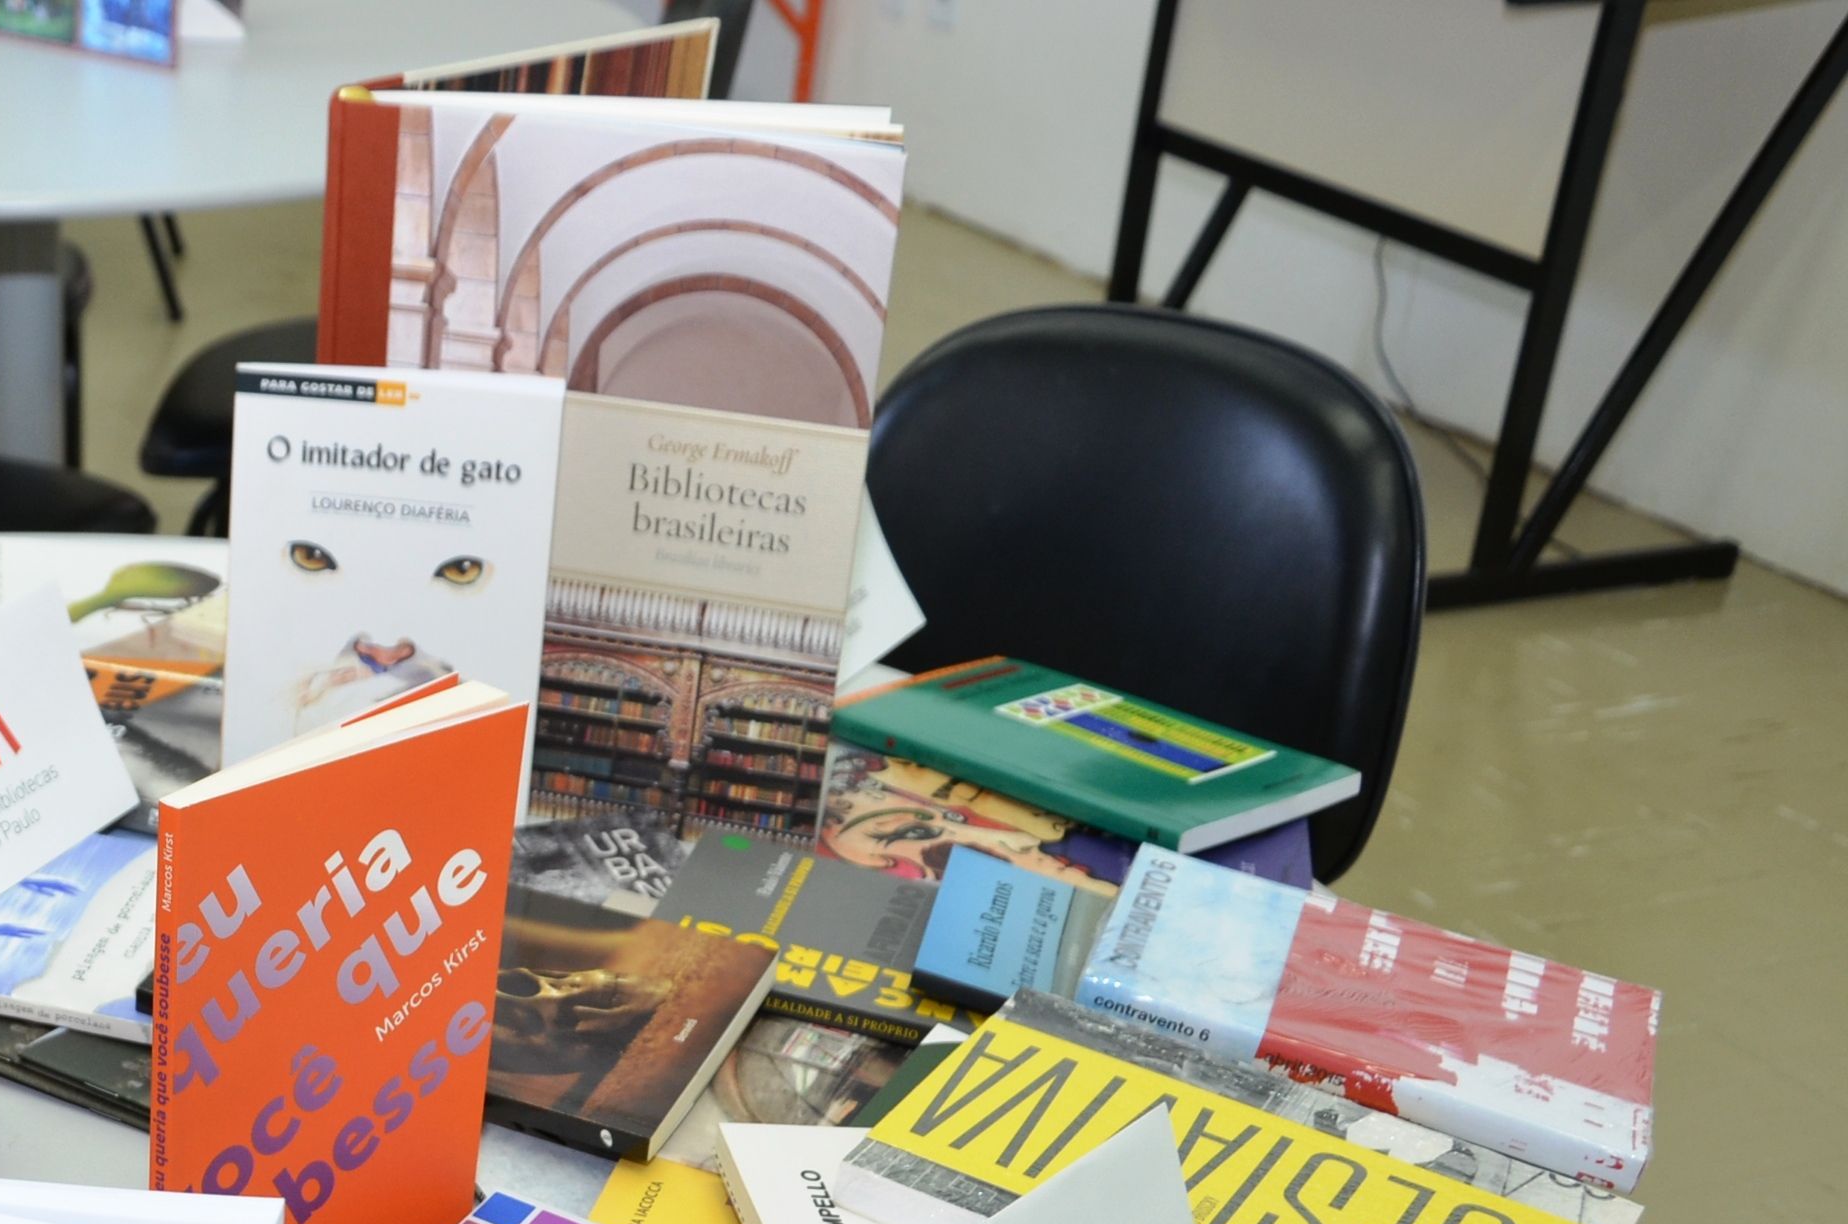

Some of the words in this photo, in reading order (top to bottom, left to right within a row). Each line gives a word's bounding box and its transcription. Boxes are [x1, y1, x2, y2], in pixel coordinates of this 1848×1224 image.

[266, 435, 291, 462] O
[301, 440, 411, 472] imitador
[419, 449, 450, 476] de
[461, 458, 522, 486] gato
[648, 433, 707, 464] George
[712, 442, 800, 475] Ermakoff
[311, 496, 396, 518] LOURENÇO
[401, 501, 470, 523] DIAFÉRIA
[628, 462, 807, 516] Bibliotecas
[632, 501, 791, 553] brasileiras
[2, 807, 43, 843] Paulo
[164, 832, 174, 860] Kirst
[583, 827, 647, 859] UR
[161, 865, 173, 912] Marcos
[980, 880, 1014, 928] Ramos
[176, 863, 263, 984] eu
[336, 848, 488, 1004] que
[1110, 870, 1172, 970] CONTRAVENTO
[1157, 857, 1178, 872] 6
[173, 828, 412, 1096] queria
[967, 925, 1000, 971] Ricardo
[157, 933, 171, 1019] soubesse
[375, 971, 444, 1042] Marcos
[443, 929, 488, 974] Kirst
[834, 1012, 845, 1023] A
[847, 1014, 862, 1027] SI
[863, 1015, 920, 1042] PRÓPRIO
[1092, 993, 1196, 1037] contravento
[1197, 1027, 1212, 1043] 6
[156, 1022, 169, 1067] você
[155, 1072, 167, 1104] que
[1302, 1063, 1346, 1087] 2015
[154, 1109, 167, 1165] queria
[636, 1181, 664, 1216] IACOCCA
